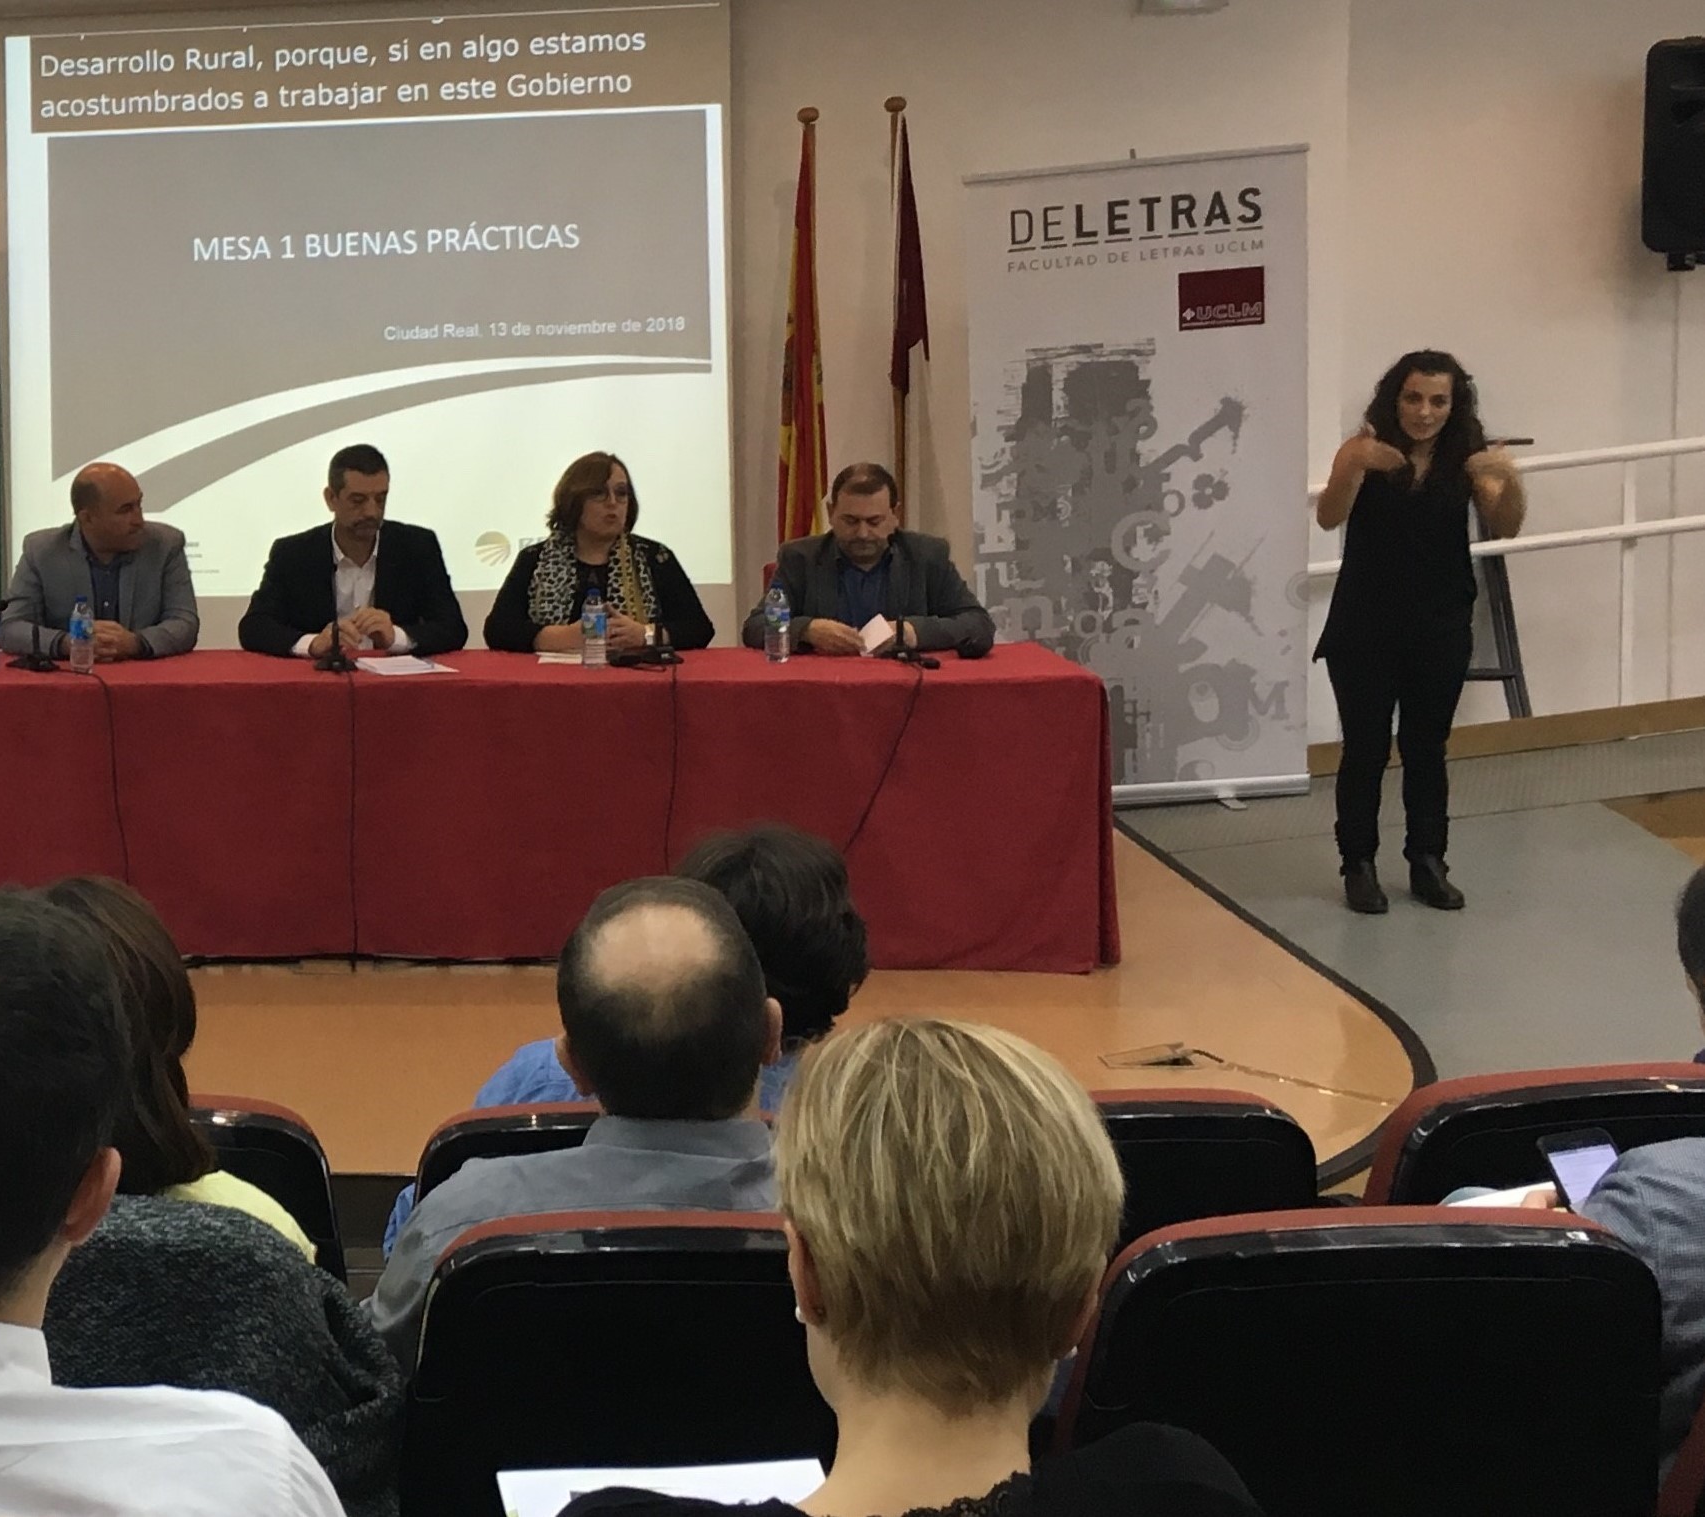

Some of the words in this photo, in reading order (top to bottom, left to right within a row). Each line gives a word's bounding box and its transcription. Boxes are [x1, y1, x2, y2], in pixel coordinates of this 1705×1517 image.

[40, 49, 175, 77] Desarrollo
[185, 45, 263, 71] Rural,
[275, 44, 378, 72] porque,
[388, 38, 409, 62] si
[419, 41, 451, 60] en
[462, 34, 519, 63] algo
[529, 31, 646, 56] estamos
[40, 88, 244, 118] acostumbrados
[253, 90, 269, 109] a
[279, 82, 387, 110] trabajar
[397, 81, 429, 103] en
[440, 77, 496, 101] este
[507, 72, 632, 98] Gobierno
[1010, 187, 1263, 246] DELETRAS
[193, 236, 272, 261] MESA
[280, 235, 296, 259] 1
[305, 229, 418, 258] BUENAS
[427, 221, 580, 254] PRÁCTICAS
[1008, 254, 1098, 273] FACULTAD
[1108, 251, 1130, 264] DE
[1140, 243, 1205, 261] LETRAS
[1214, 239, 1264, 255] UCLM
[383, 324, 438, 341] Ciudad
[489, 322, 507, 336] 13
[512, 321, 531, 336] de
[535, 319, 617, 336] noviembre
[621, 318, 642, 333] de
[645, 317, 685, 332] 2018
[1196, 301, 1263, 321] UCLM
